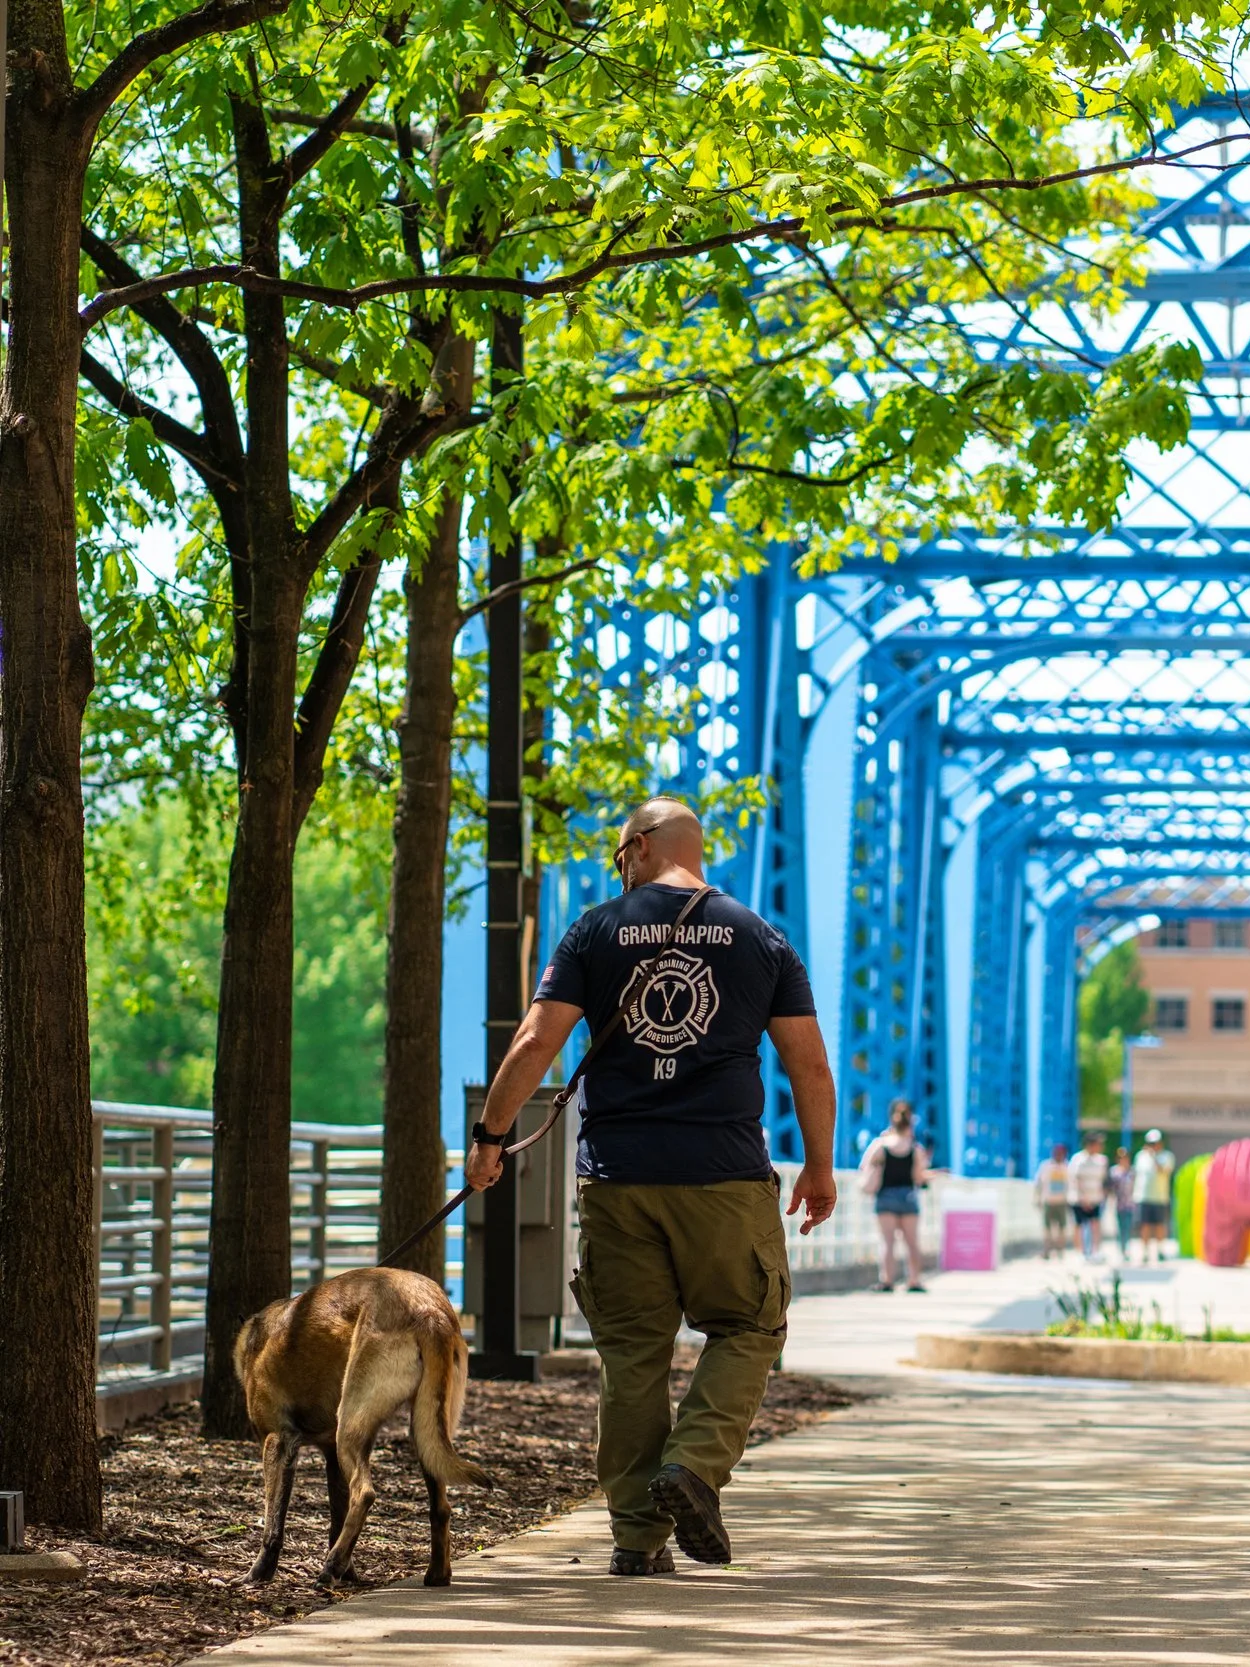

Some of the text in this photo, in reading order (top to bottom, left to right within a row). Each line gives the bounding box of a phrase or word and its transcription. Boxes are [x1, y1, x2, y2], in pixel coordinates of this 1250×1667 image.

[618, 924, 734, 946] GRAND RAPIDS
[694, 980, 709, 1023] BOARDING
[646, 1029, 688, 1043] OBEDIENCE
[653, 1057, 677, 1080] K9
